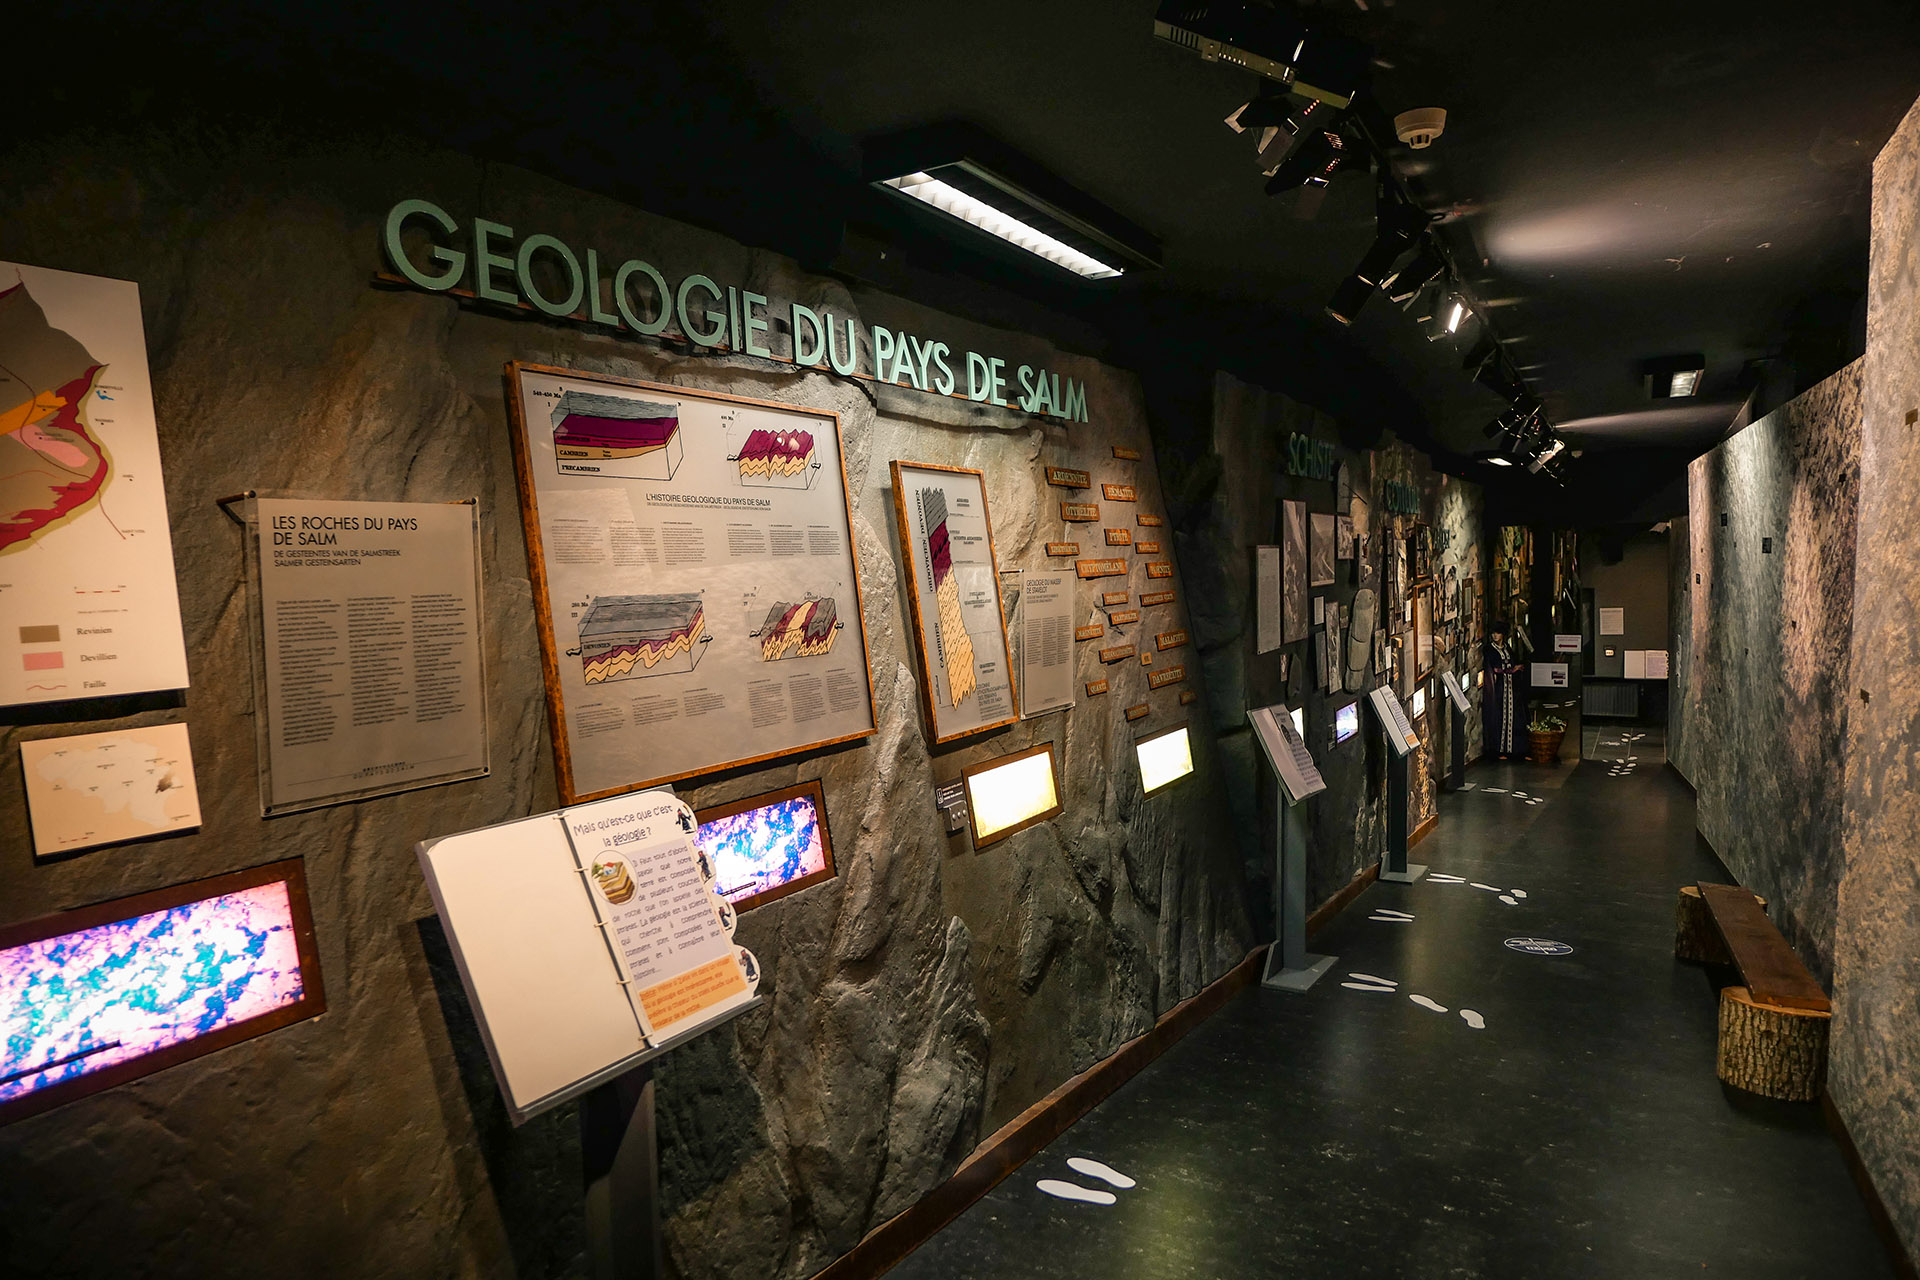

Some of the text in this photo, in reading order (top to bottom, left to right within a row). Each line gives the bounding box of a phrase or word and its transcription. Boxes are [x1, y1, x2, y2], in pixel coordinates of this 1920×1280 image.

[384, 199, 1088, 423] GEOLOGIE DU PAYS DE SALM
[645, 493, 771, 507] L'HISTOIRE GEOLOGIQUE DU PAYS DE SALM
[272, 516, 418, 531] LES ROCHES DU PAYS
[273, 532, 338, 546] DE SALM
[274, 550, 284, 558] DE
[285, 550, 331, 558] GESTEENTES
[361, 549, 401, 557] SALMSTREEK
[274, 558, 361, 567] SALMER GESTEINSARTEN
[83, 680, 107, 689] Faille
[573, 805, 674, 837] Mais qu'est-ce que c'est
[602, 826, 652, 847] la géologie ?
